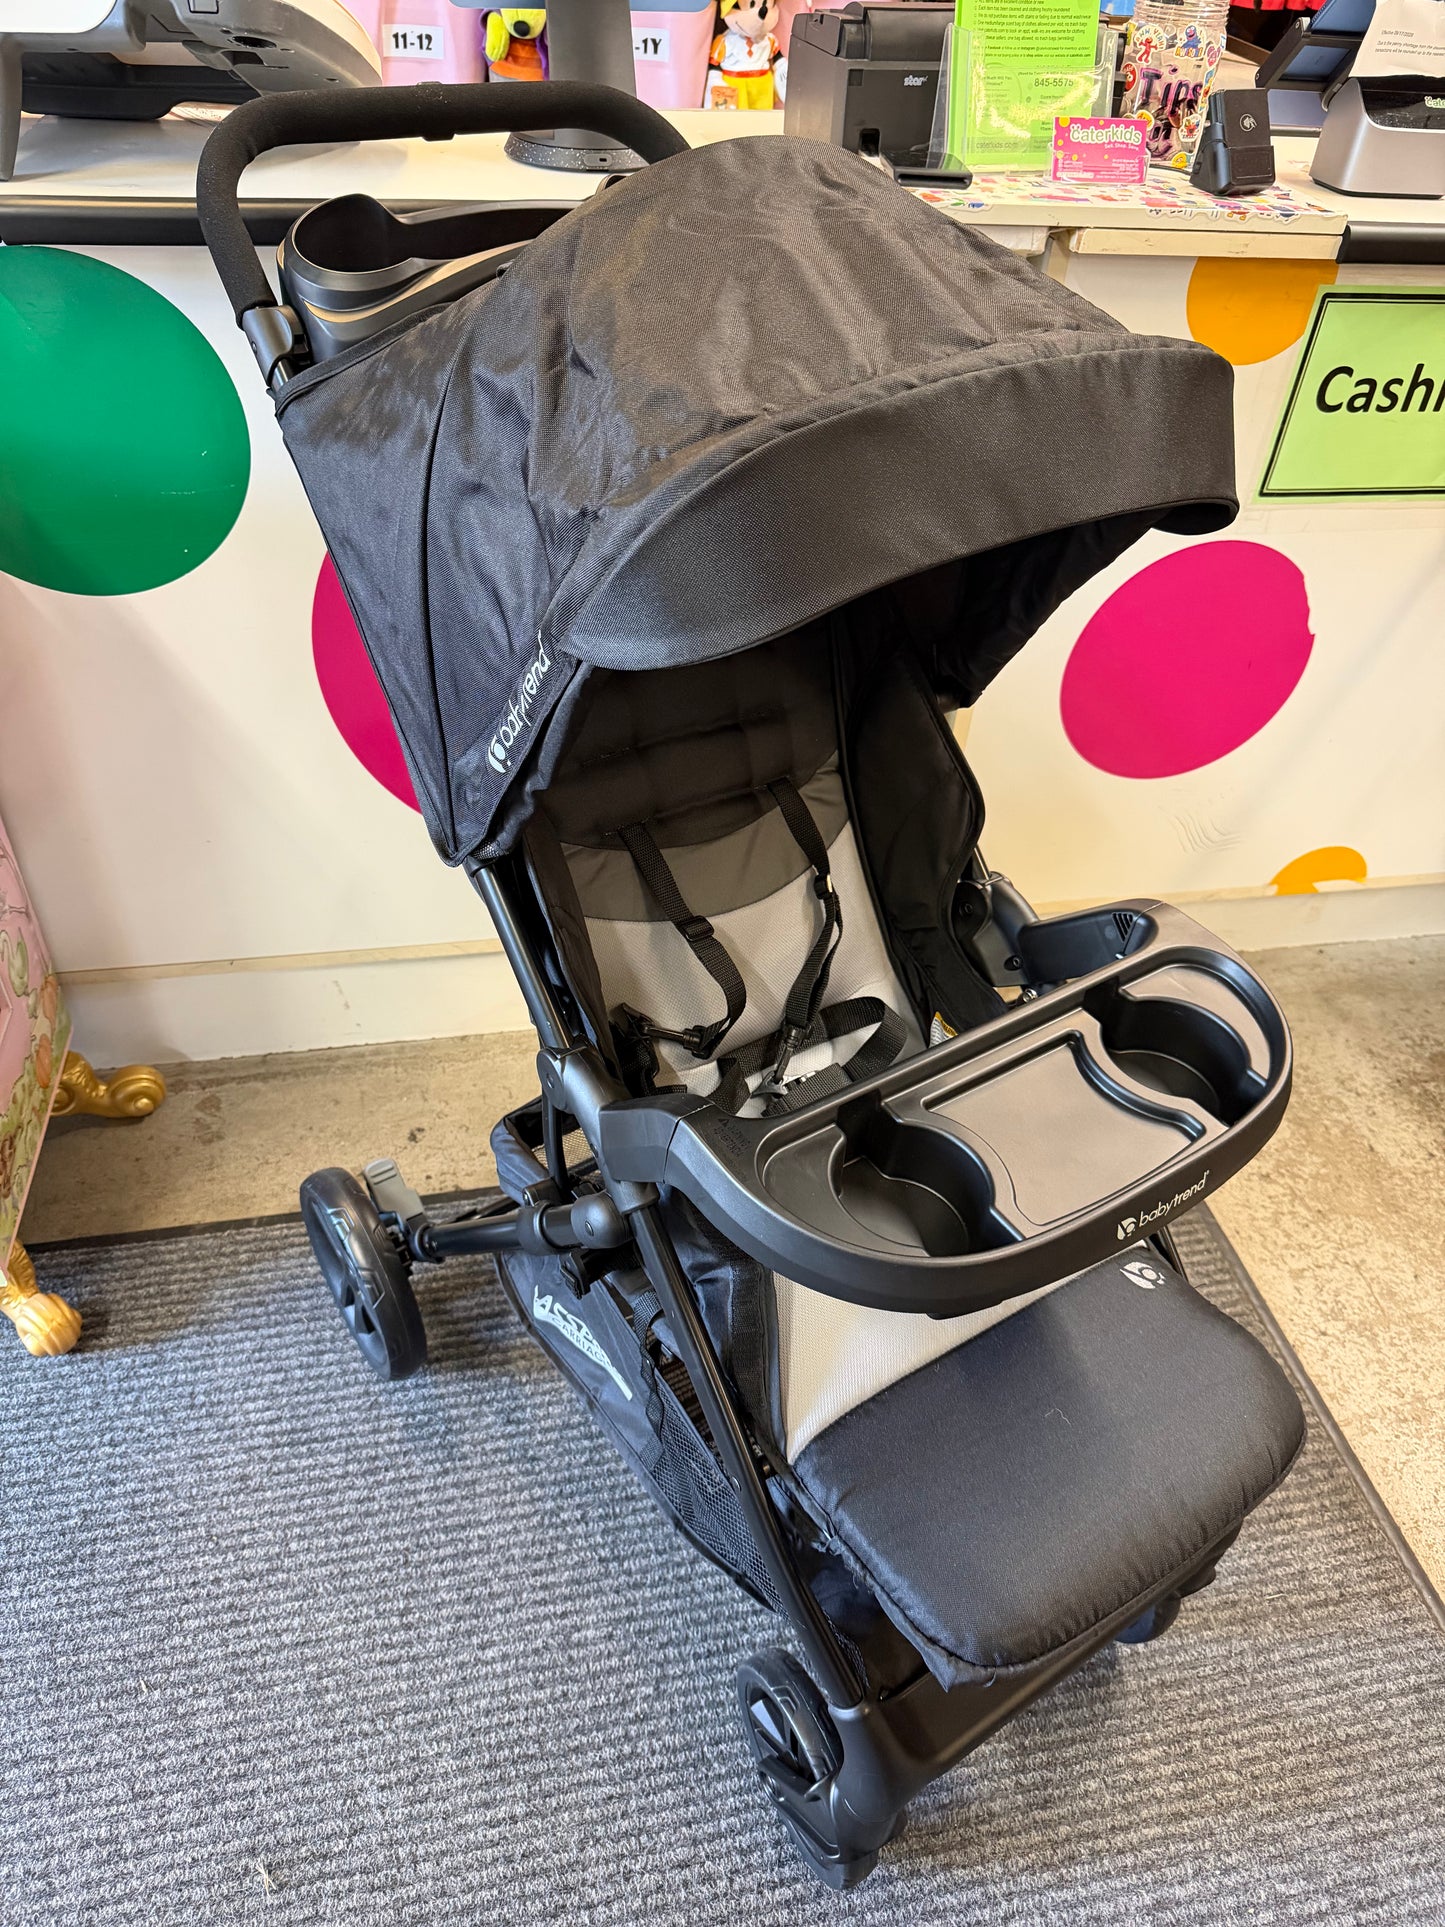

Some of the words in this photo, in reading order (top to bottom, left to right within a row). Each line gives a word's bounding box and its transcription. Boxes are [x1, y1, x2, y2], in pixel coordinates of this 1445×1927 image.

[392, 32, 433, 51] 11-12
[1034, 78, 1074, 87] 845-5575
[1139, 1171, 1207, 1228] babytrend
